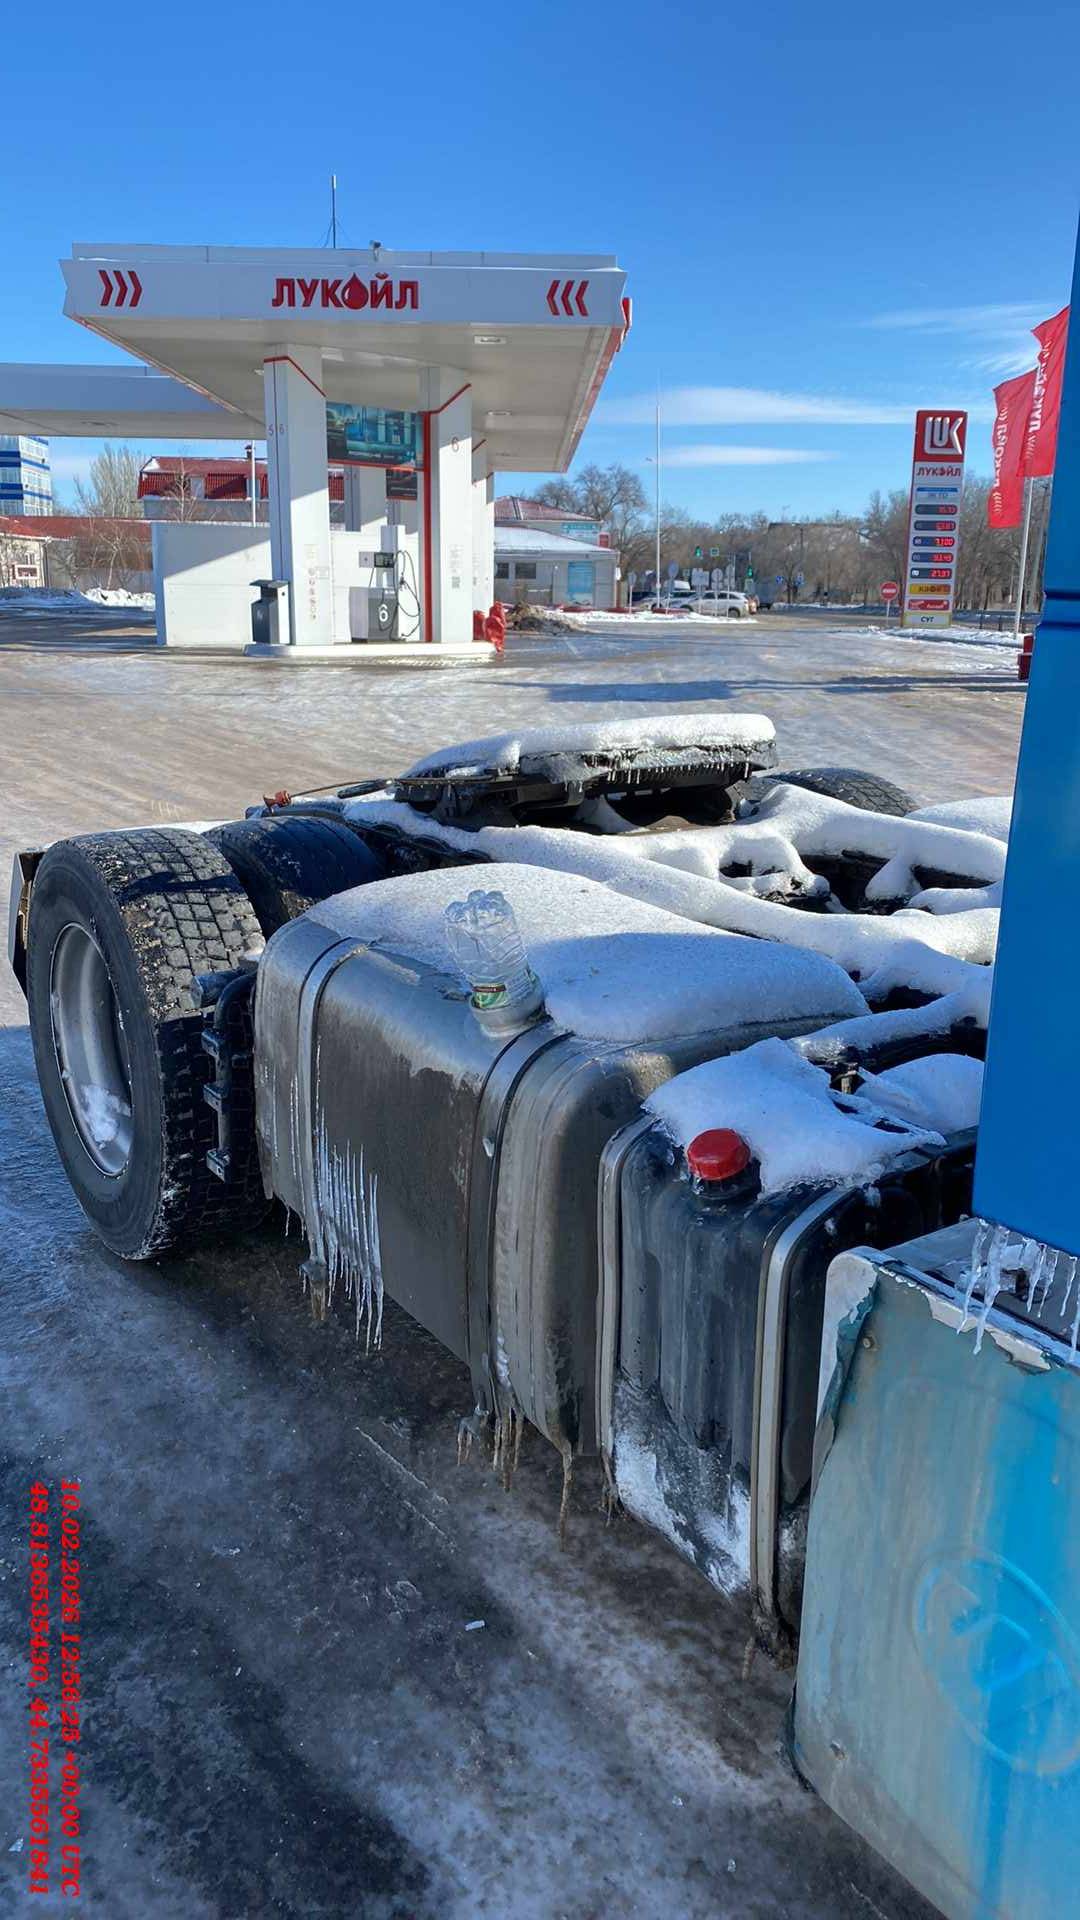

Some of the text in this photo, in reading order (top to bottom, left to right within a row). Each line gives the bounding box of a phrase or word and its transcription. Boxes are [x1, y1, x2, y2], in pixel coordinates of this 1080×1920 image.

[272, 271, 419, 310] ЛУКОЙЛ
[451, 436, 460, 452] 6
[917, 465, 962, 477] ЛУКОЙЛ
[378, 603, 389, 622] 6
